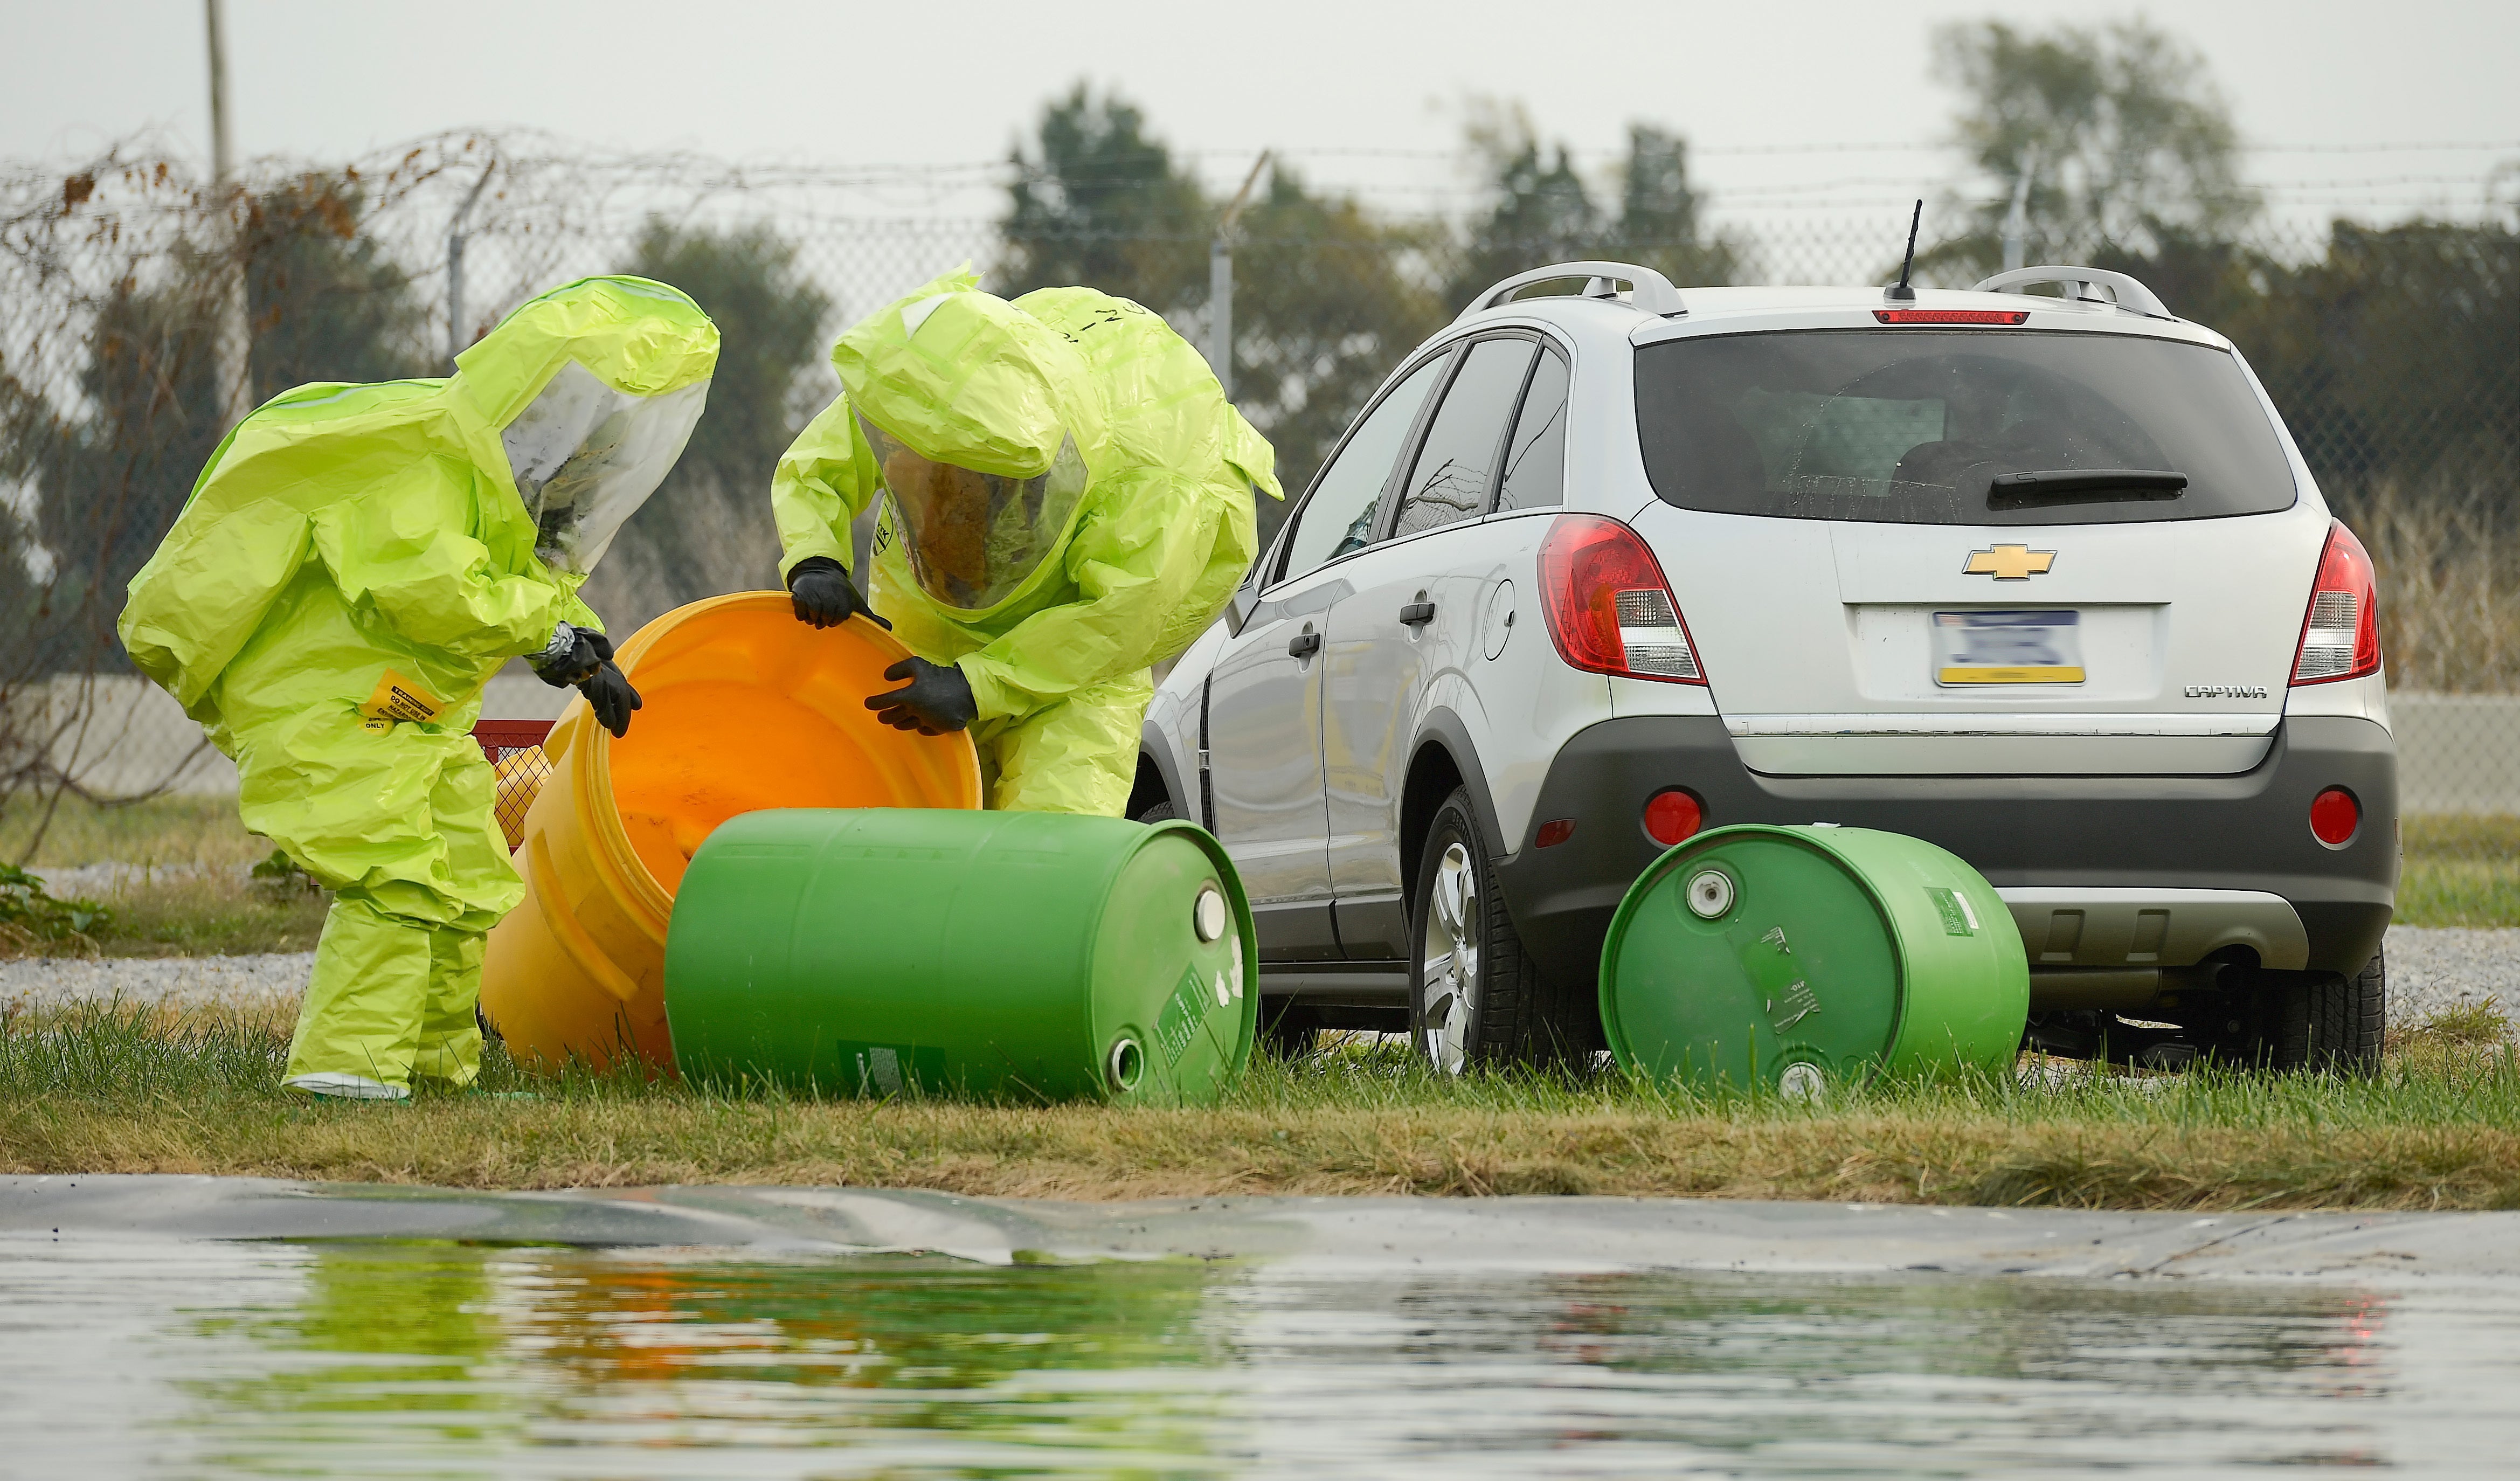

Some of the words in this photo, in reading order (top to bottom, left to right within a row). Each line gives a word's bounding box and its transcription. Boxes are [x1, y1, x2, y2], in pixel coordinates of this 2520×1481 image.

[394, 688, 421, 708] TRAINING
[2185, 685, 2267, 698] CAPTIVA
[391, 695, 400, 704] DO
[400, 702, 411, 712] NOT
[410, 708, 421, 718] USE
